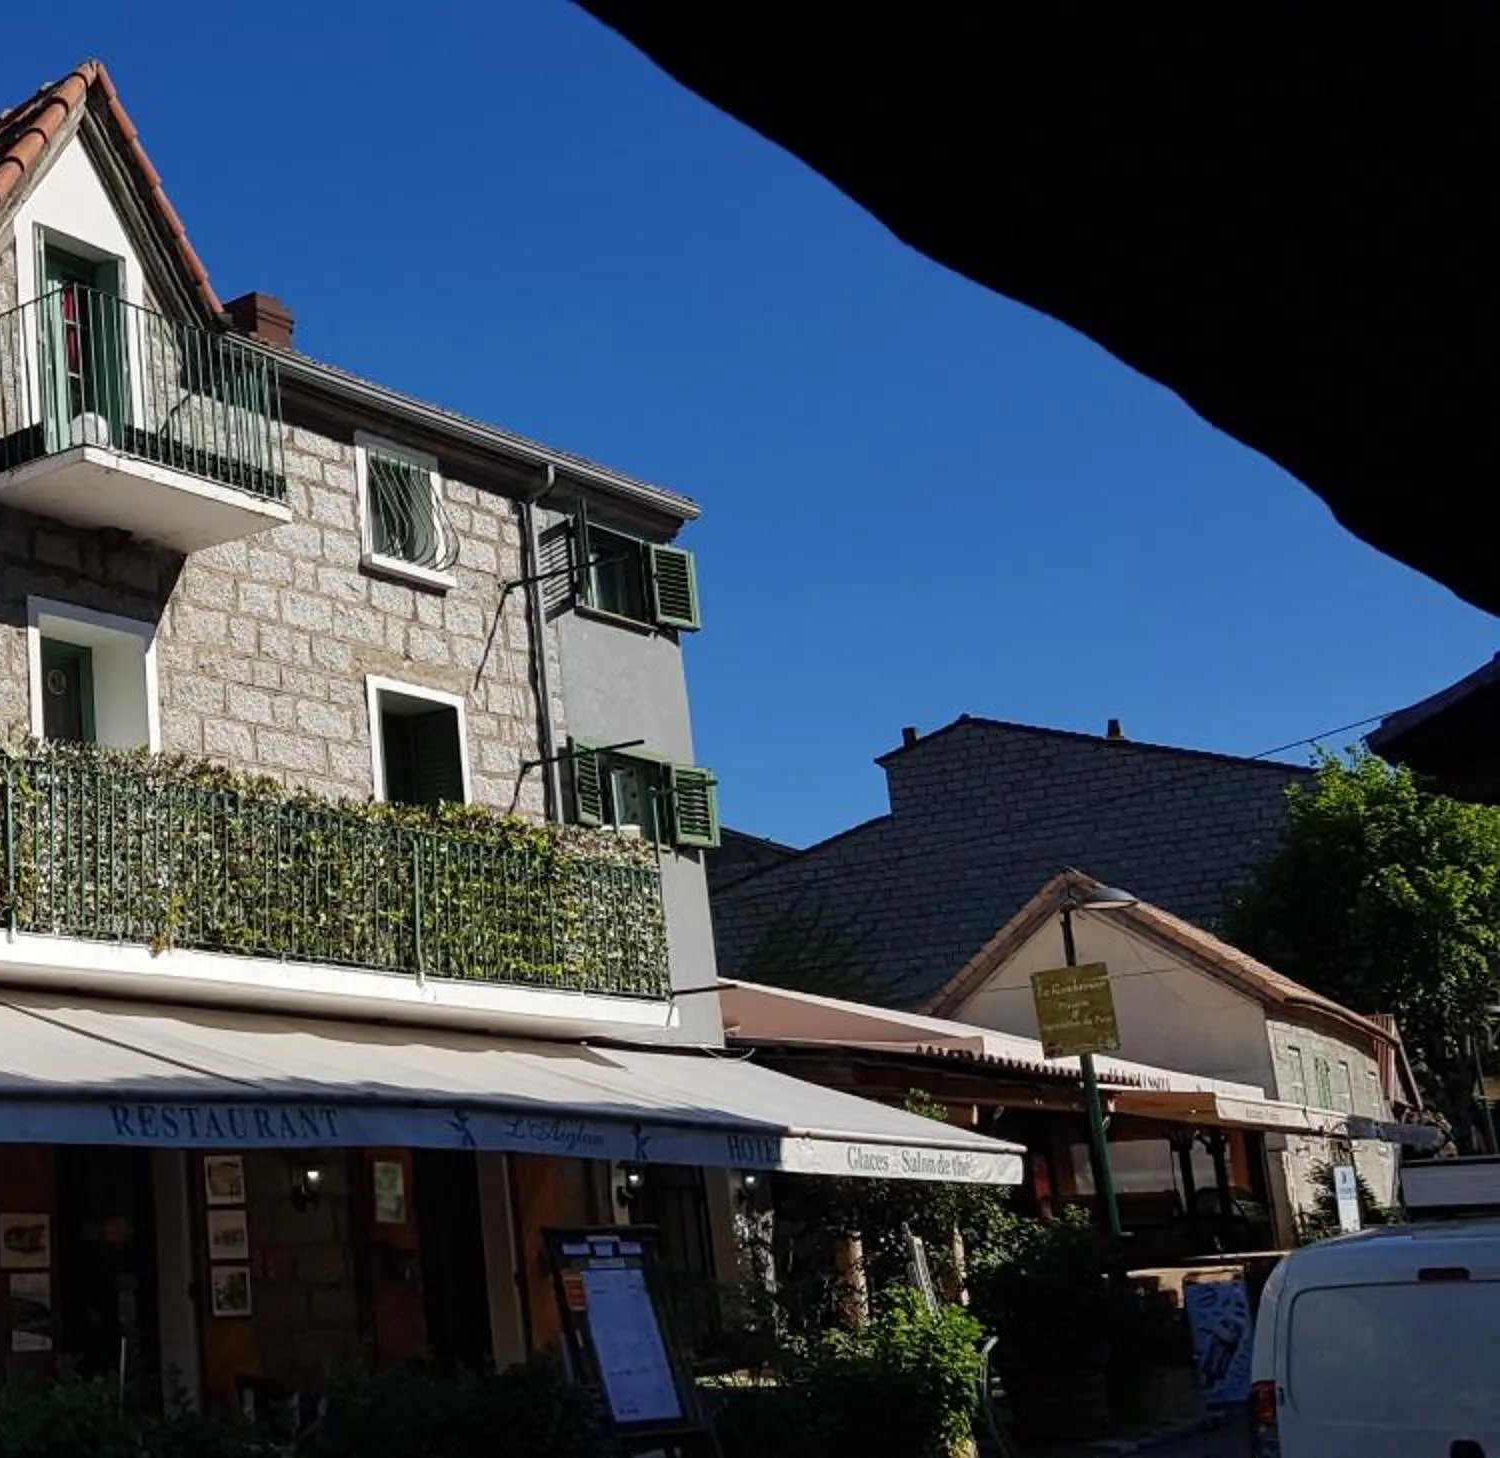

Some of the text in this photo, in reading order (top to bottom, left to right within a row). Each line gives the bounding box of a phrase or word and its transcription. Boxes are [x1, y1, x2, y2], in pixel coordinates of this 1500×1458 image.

[110, 1104, 343, 1139] RESTAURANT
[503, 1117, 607, 1150] L'Aiglon
[847, 1146, 889, 1172] Glaces
[902, 1150, 935, 1174] Salon
[935, 1153, 951, 1175] de
